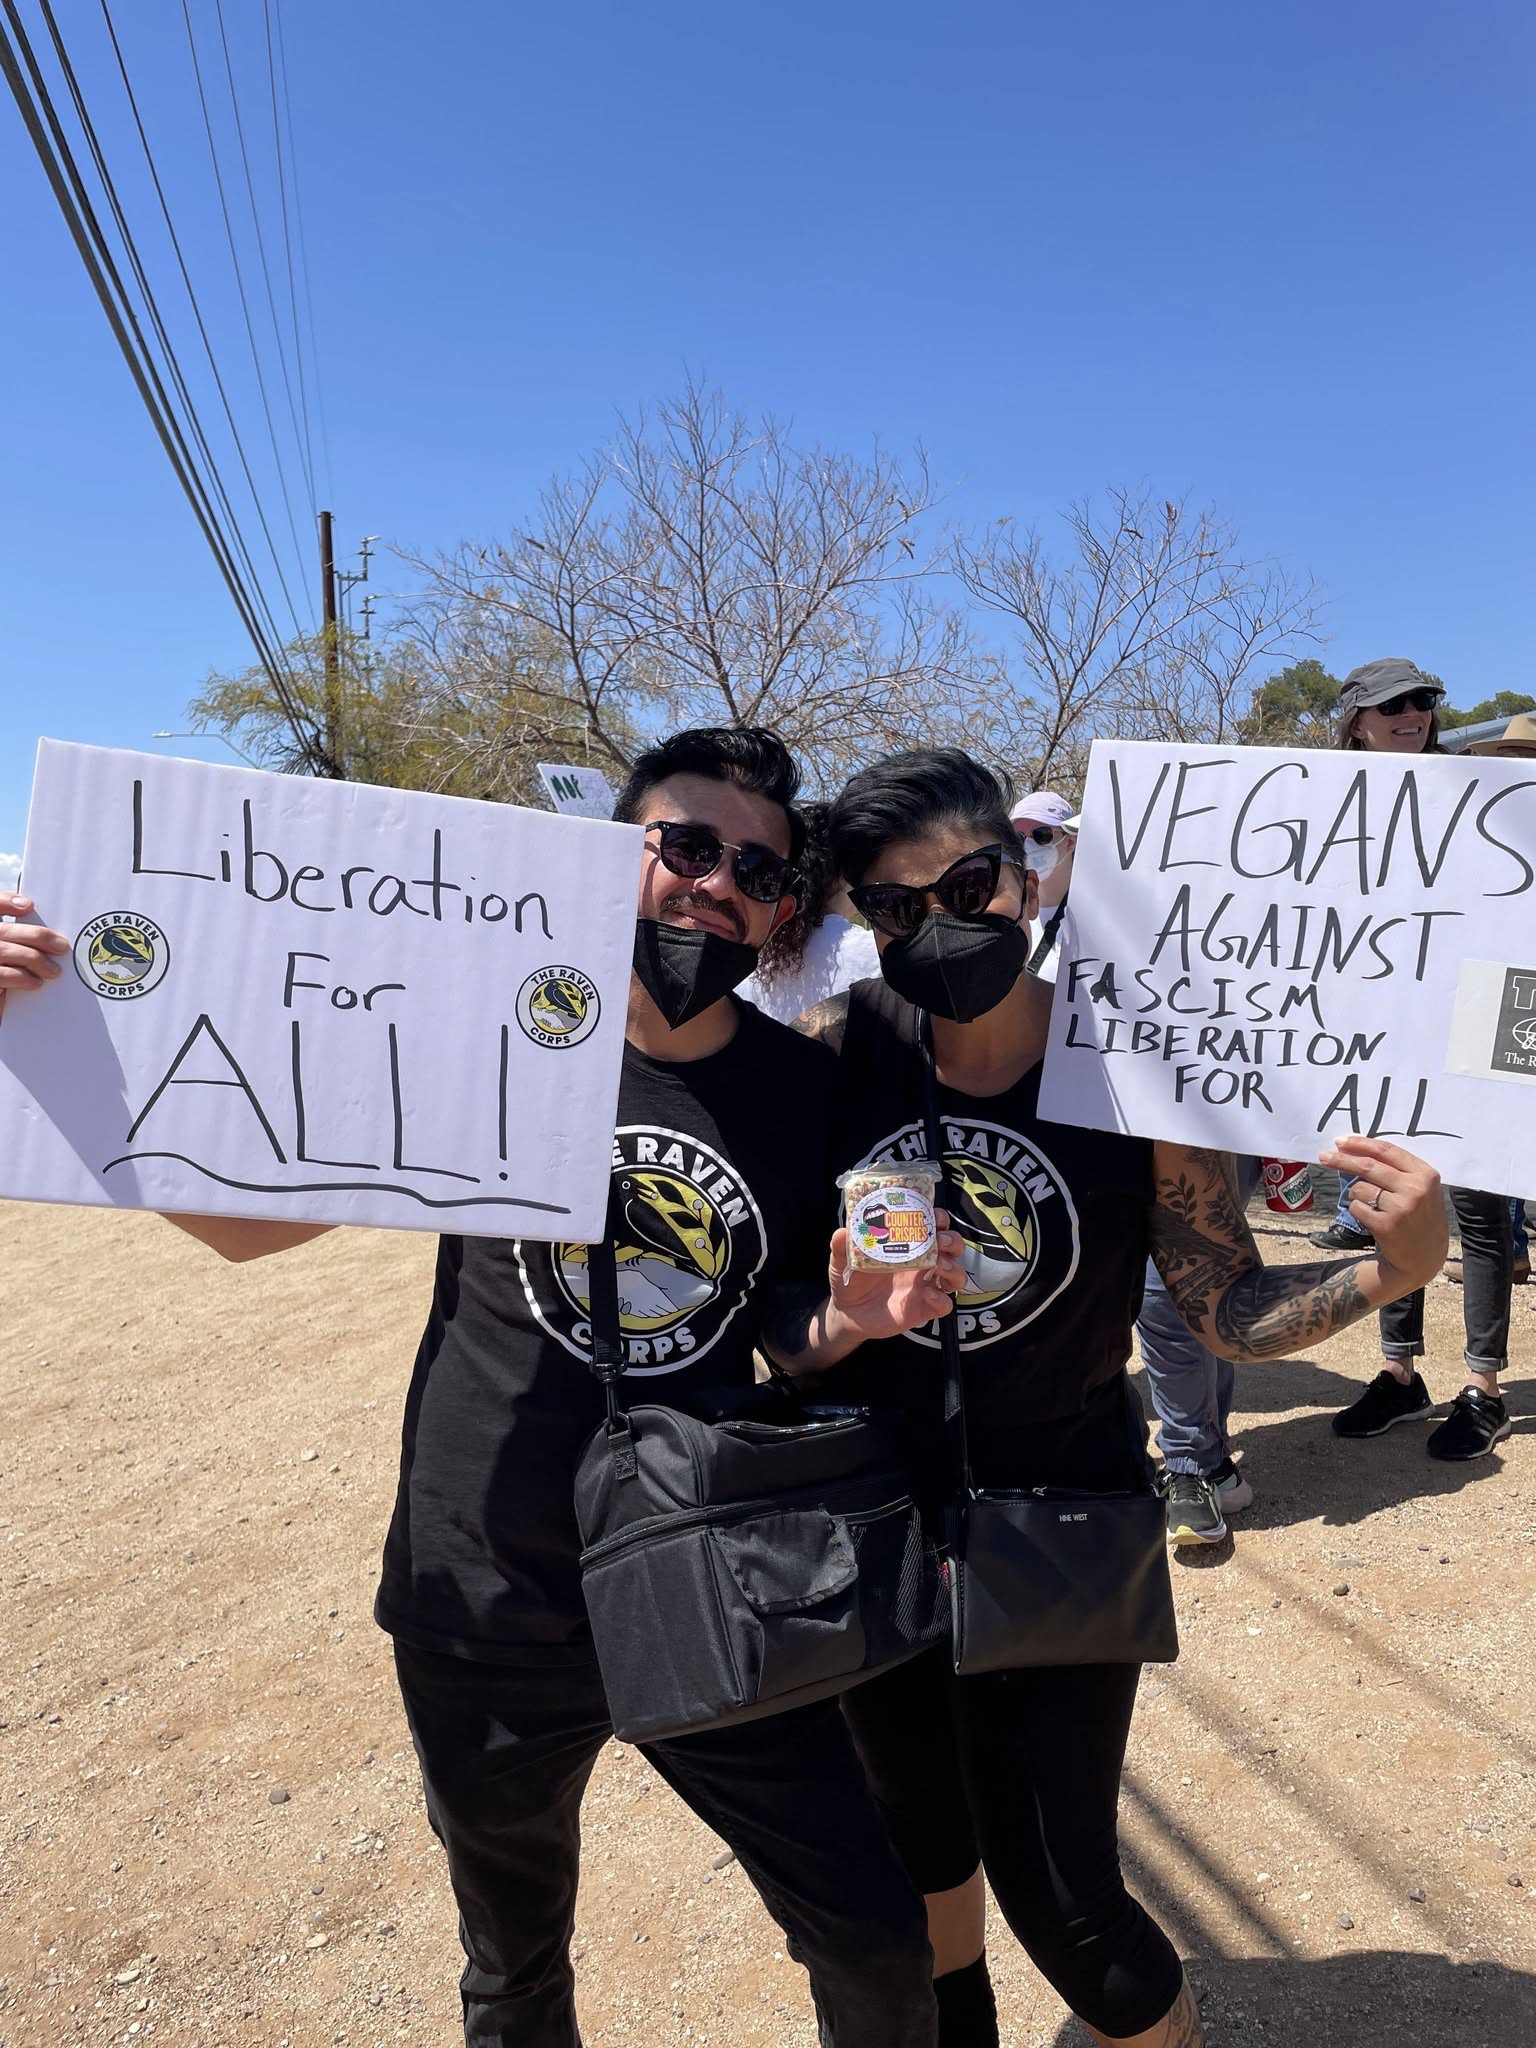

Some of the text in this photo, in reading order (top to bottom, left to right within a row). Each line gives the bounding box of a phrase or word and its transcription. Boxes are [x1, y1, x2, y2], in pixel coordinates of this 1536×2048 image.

[1109, 758, 1536, 897] VEGANS
[132, 780, 553, 940] Liberation
[84, 915, 160, 941] THE RAVEN
[1149, 884, 1465, 982] AGAINST
[97, 982, 145, 996] CORPS
[284, 951, 406, 1011] For
[530, 969, 595, 1001] THE RAVEN
[1067, 958, 1326, 1029] FASCISM
[530, 1027, 571, 1045] CORPS
[1065, 1013, 1387, 1067] LIBERATION
[1504, 1051, 1526, 1066] The
[126, 1013, 509, 1182] ALL!
[1175, 1064, 1464, 1139] FOR ALL
[637, 1136, 750, 1229] RAVEN
[946, 1126, 1056, 1204] RAVEN
[885, 1211, 924, 1227] COUNTER
[889, 1226, 928, 1242] CRISPIES
[571, 1321, 697, 1364] CRPS
[1072, 1513, 1088, 1521] WEST
